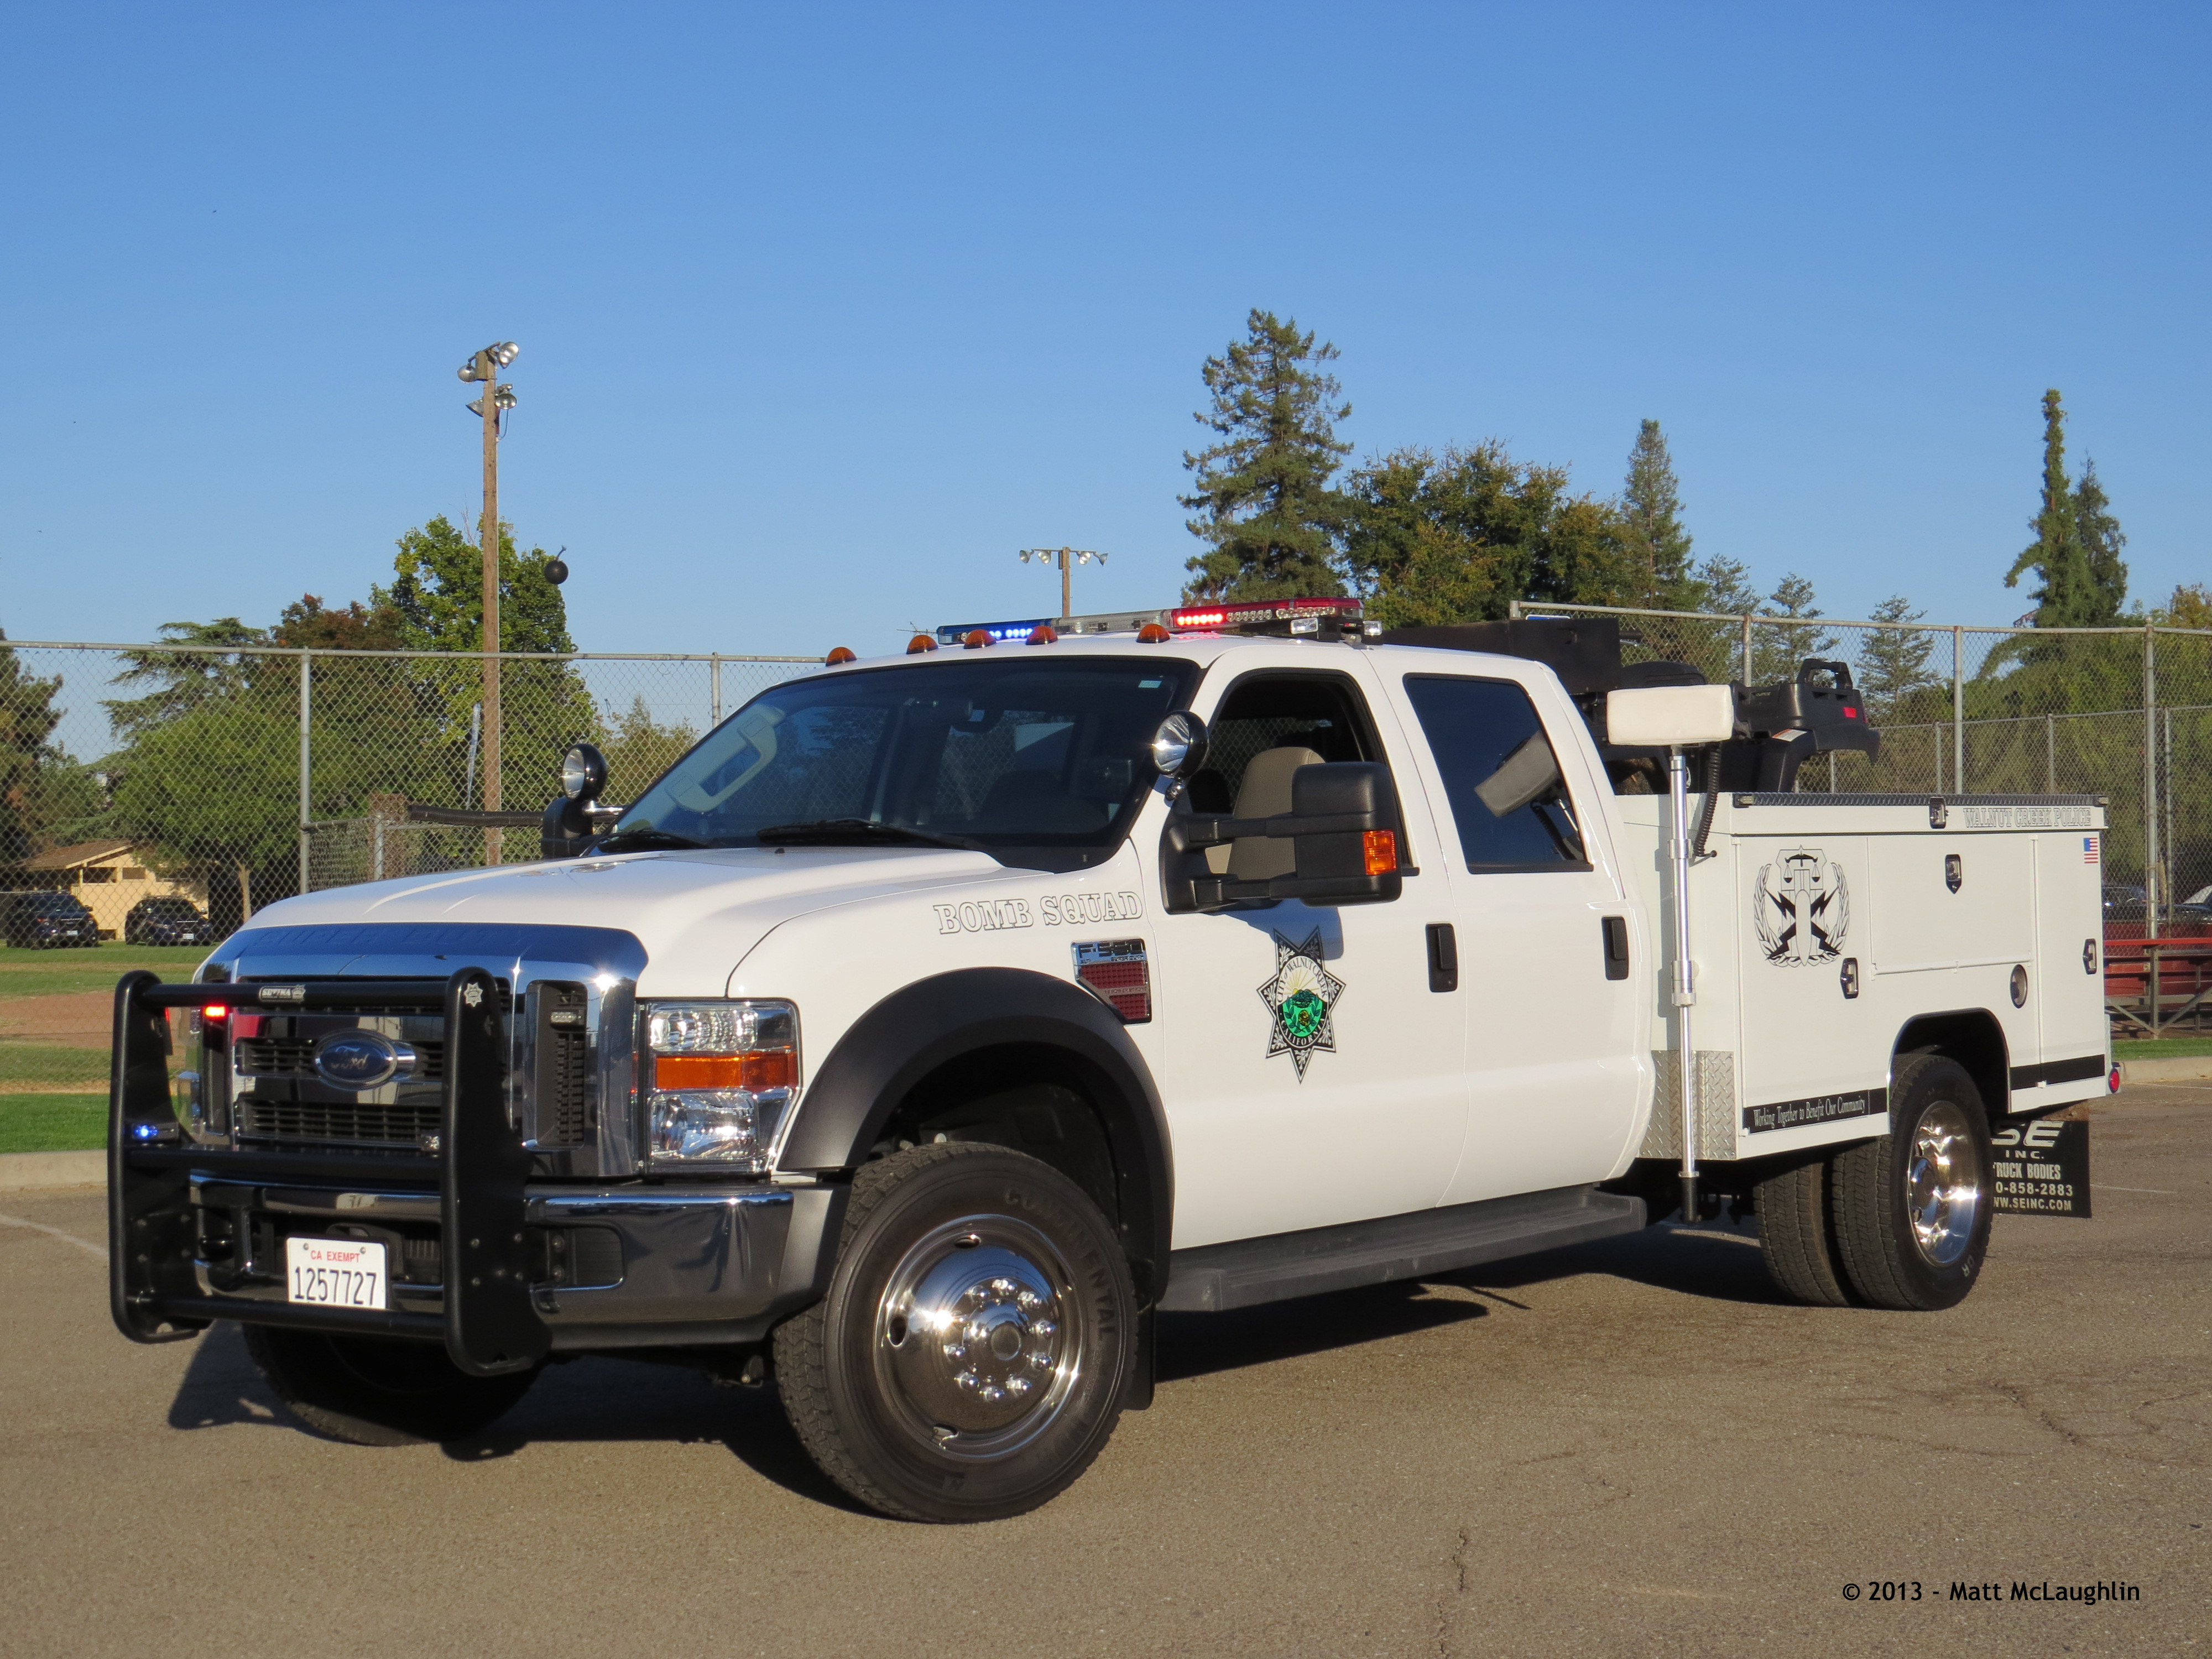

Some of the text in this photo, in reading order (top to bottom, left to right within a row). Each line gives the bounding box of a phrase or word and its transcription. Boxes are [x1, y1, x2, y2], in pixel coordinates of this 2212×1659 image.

[1963, 807, 2091, 828] WALNUT CREEK POLICE
[933, 891, 1143, 934] BOMB SQUAD
[1286, 957, 1313, 972] WALNUT
[1312, 965, 1328, 998] CREEK
[1281, 1018, 1325, 1046] CALIFORNIA
[1754, 1095, 1865, 1129] Working Together to Benefit Our Community
[2005, 1150, 2044, 1159] INC.
[2027, 1163, 2061, 1180] BODIES
[310, 1250, 359, 1262] CA EXEMPT
[295, 1266, 377, 1305] 1257727
